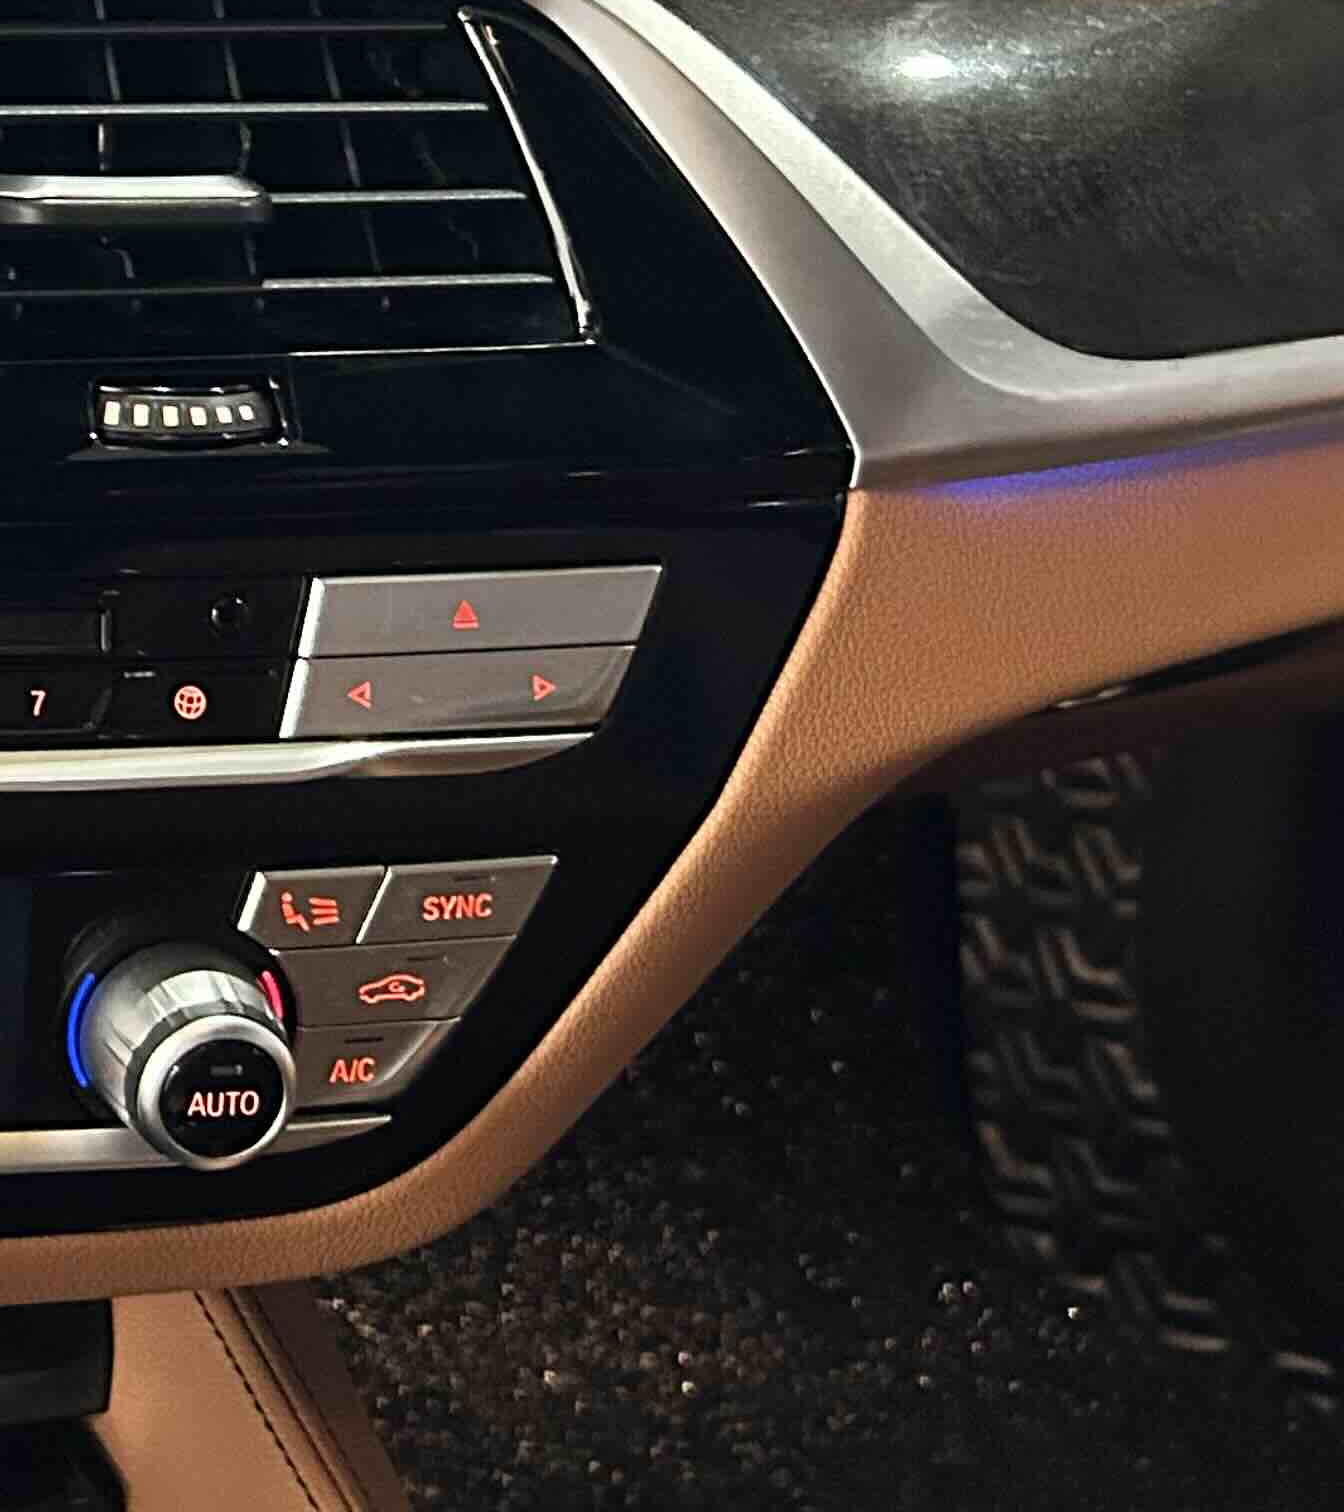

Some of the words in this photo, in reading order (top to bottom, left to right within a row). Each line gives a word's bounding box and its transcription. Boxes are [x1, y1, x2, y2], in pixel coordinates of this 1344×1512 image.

[29, 689, 46, 718] 7
[422, 892, 493, 922] SYNC
[329, 1057, 376, 1085] A/C
[186, 1090, 260, 1118] AUTO
